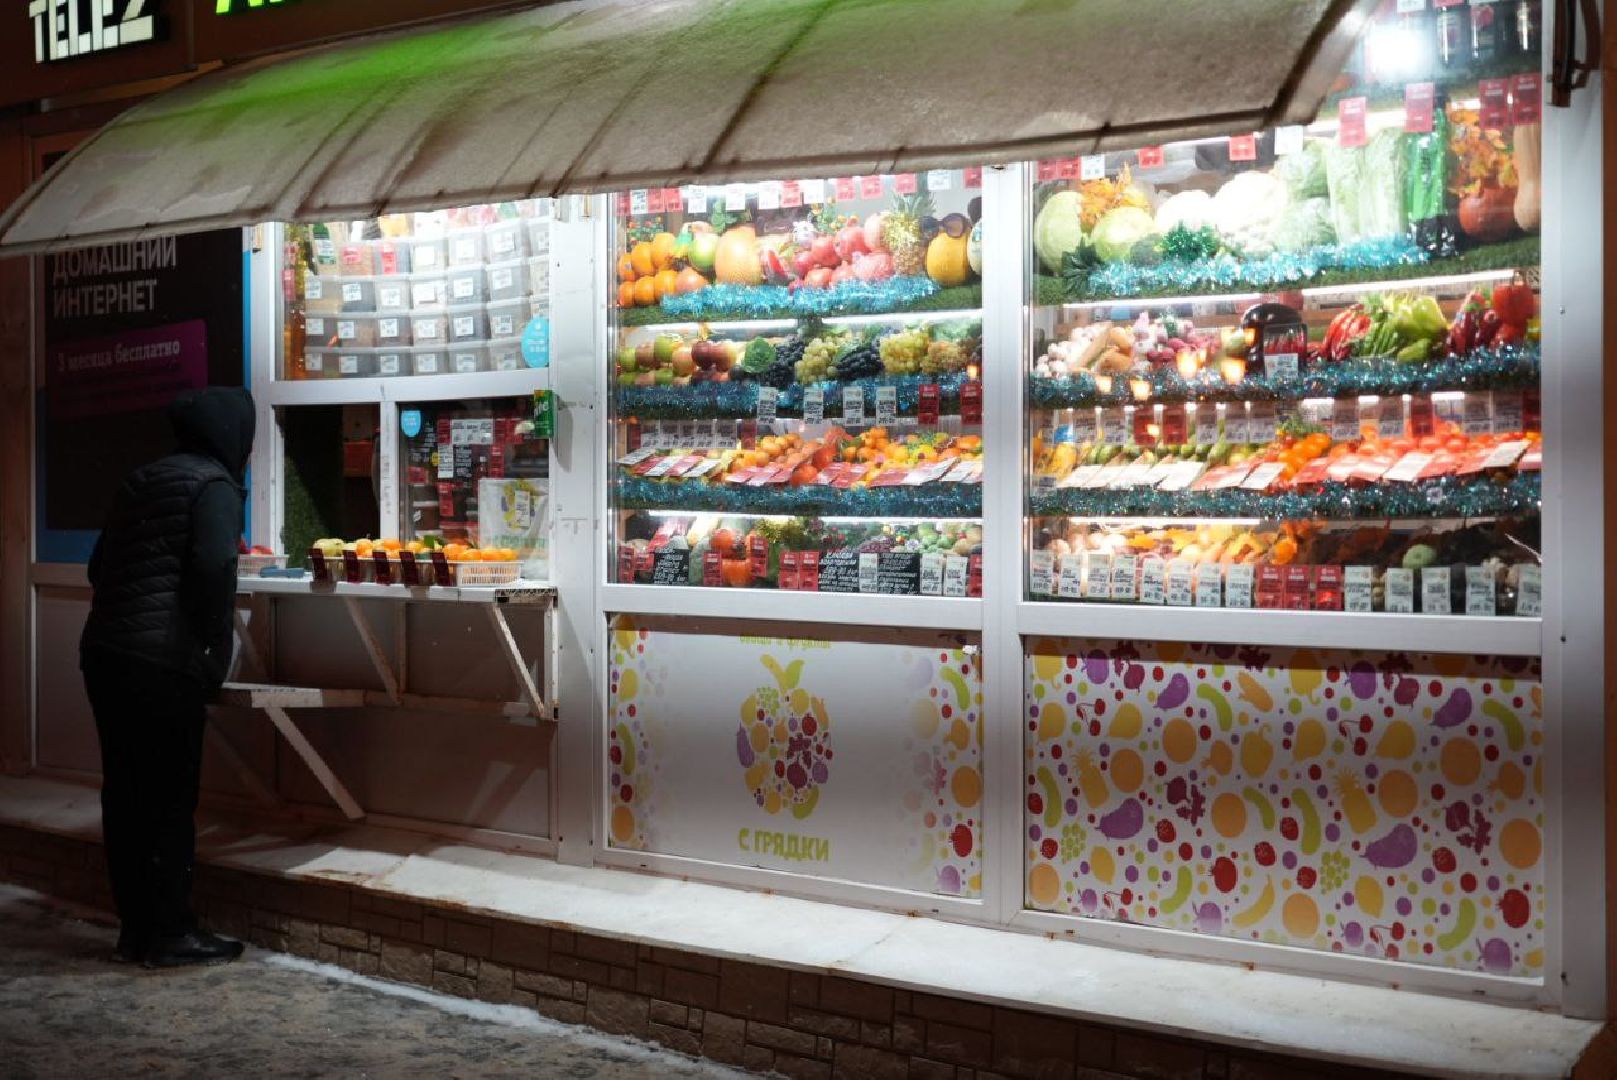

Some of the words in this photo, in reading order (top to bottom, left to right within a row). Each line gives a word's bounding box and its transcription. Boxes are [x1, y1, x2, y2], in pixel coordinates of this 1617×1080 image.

[29, 0, 154, 63] TELE2
[54, 279, 157, 319] ИНТЕРНЕТ
[115, 340, 180, 364] бесплатно
[739, 827, 750, 851] С
[754, 830, 829, 862] ГРЯДКИ
